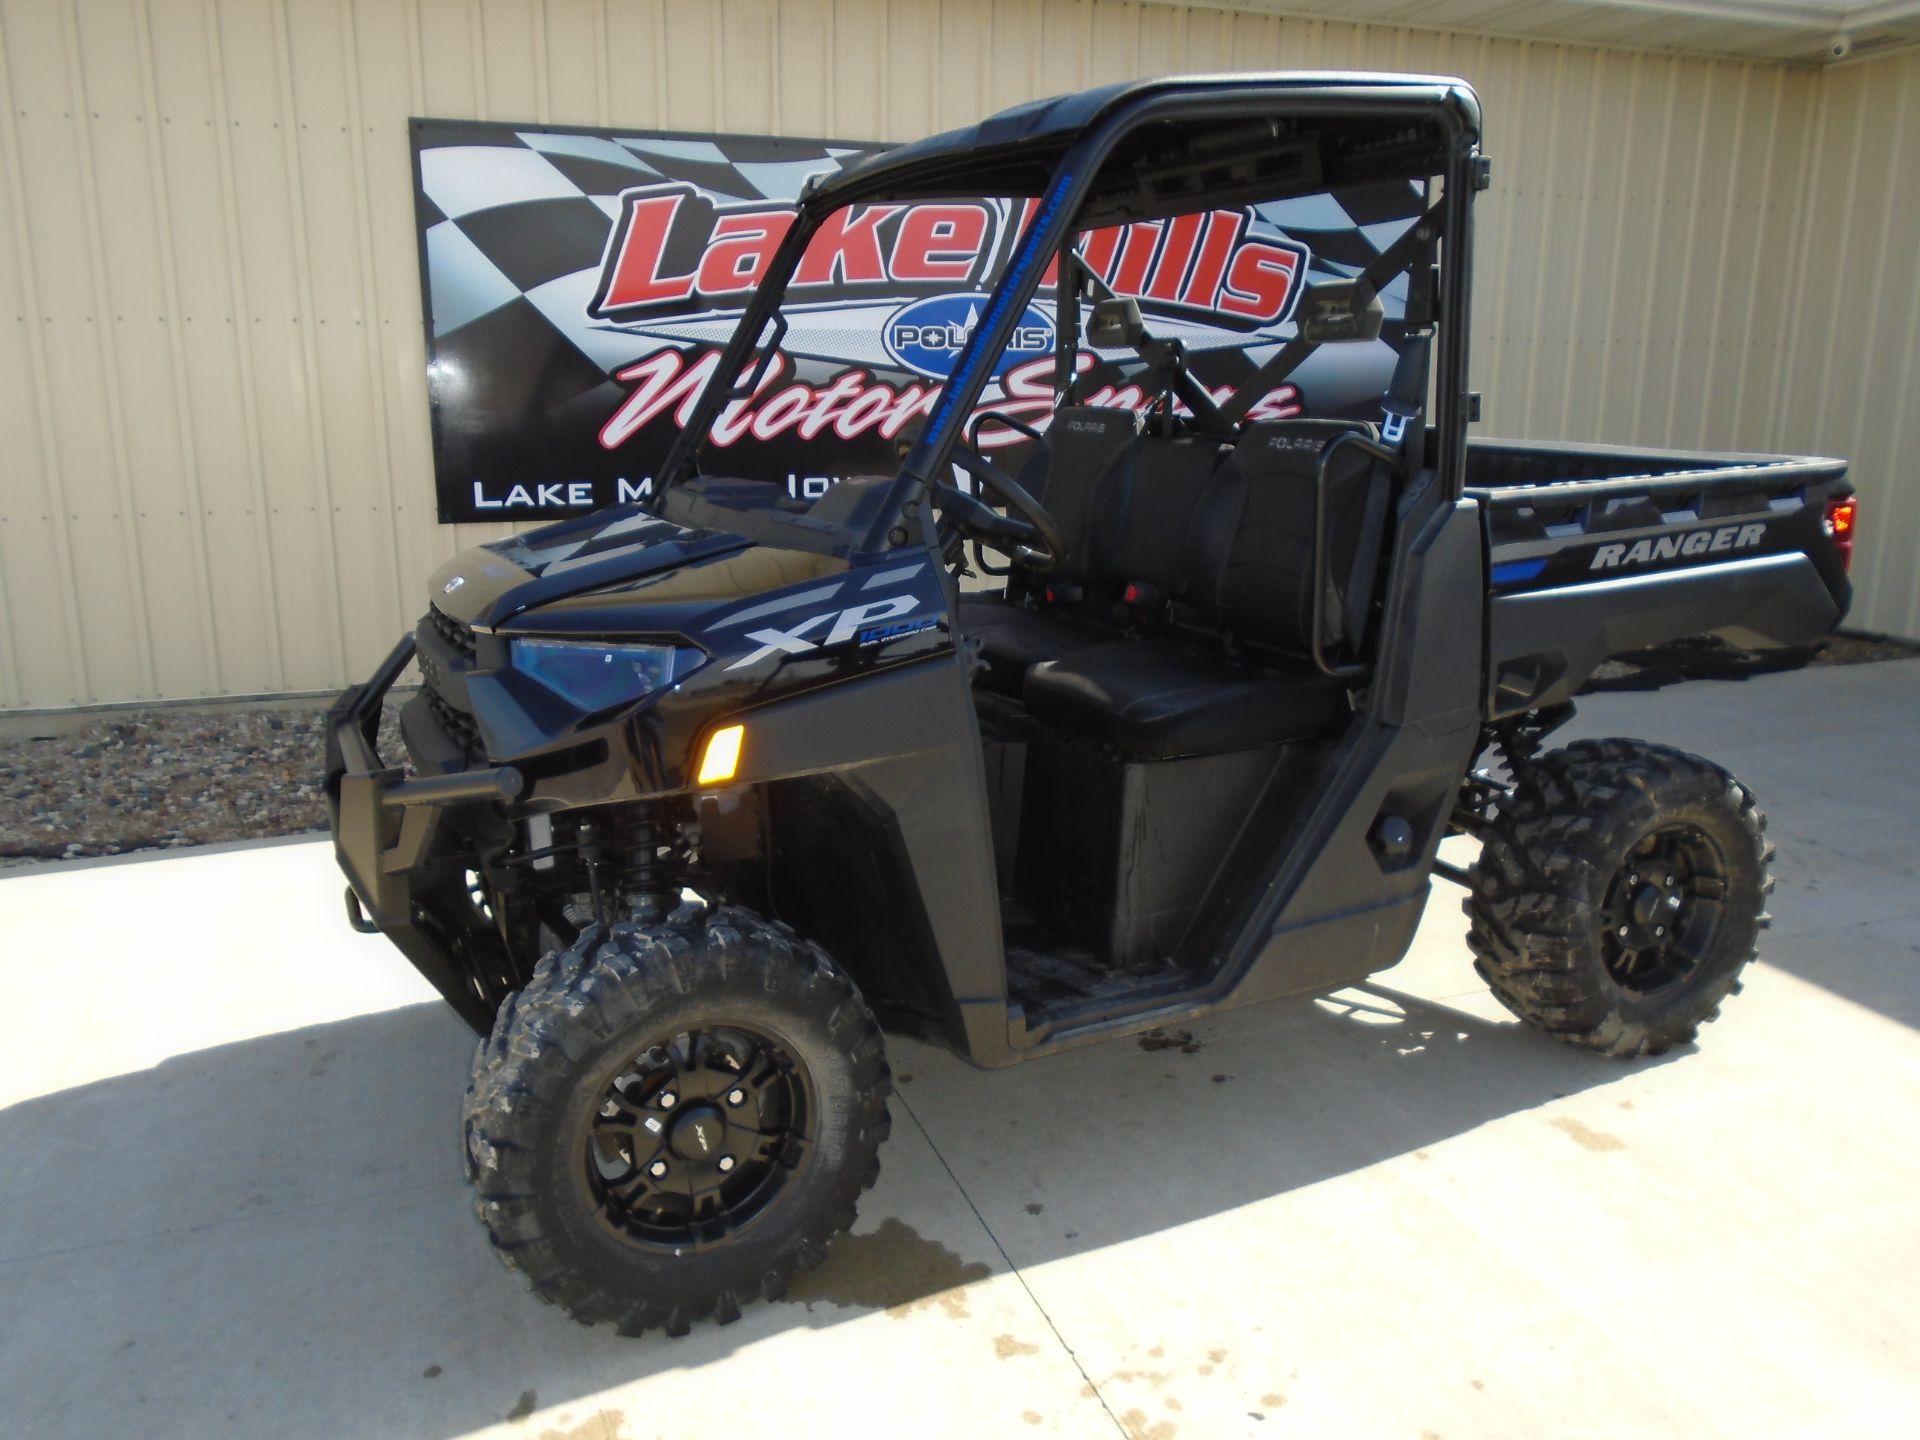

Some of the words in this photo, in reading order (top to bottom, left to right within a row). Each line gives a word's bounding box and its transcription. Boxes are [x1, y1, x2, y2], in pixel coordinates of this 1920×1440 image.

[598, 193, 986, 309] Lake
[893, 324, 1050, 352] POLIS
[474, 481, 593, 506] LAKE
[1590, 523, 1766, 570] RANGER
[724, 594, 920, 671] XP
